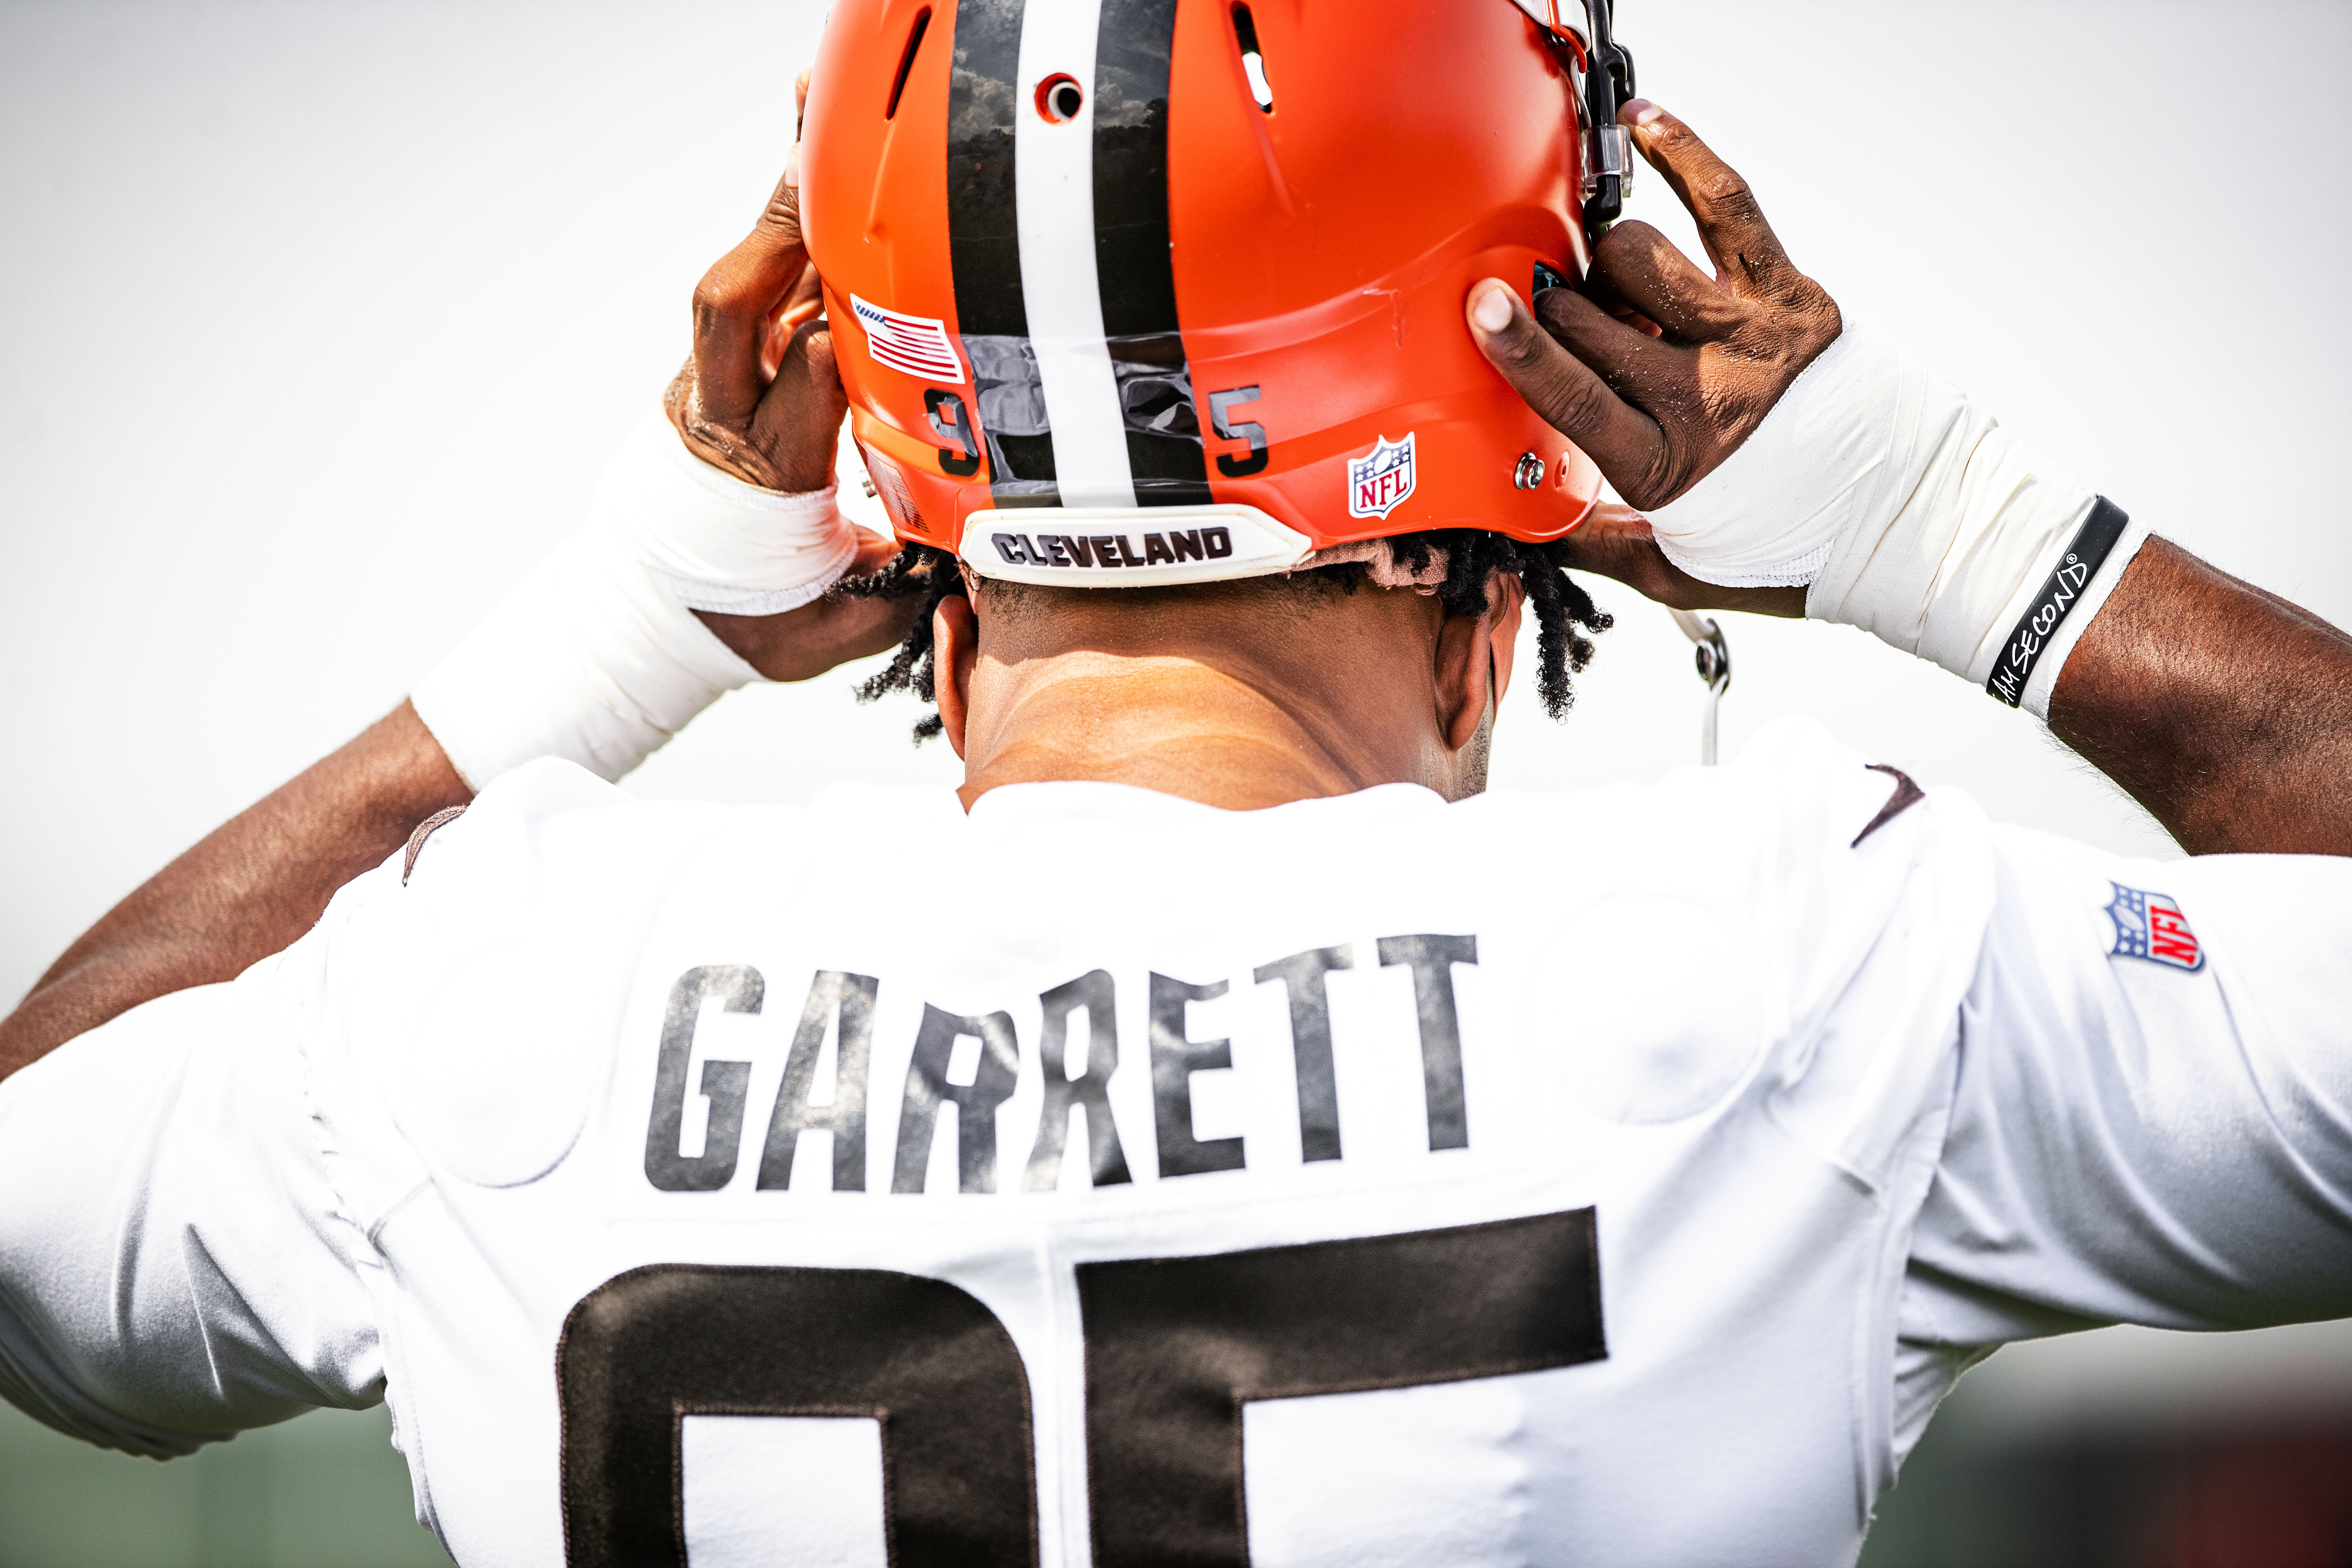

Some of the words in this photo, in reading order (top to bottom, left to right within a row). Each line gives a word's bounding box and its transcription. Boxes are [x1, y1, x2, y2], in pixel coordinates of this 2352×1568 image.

[924, 388, 980, 477] 9
[1208, 384, 1267, 478] 5
[1359, 468, 1407, 508] NFL
[991, 526, 1233, 568] CLEVELAND
[643, 934, 1480, 1195] GARRETT
